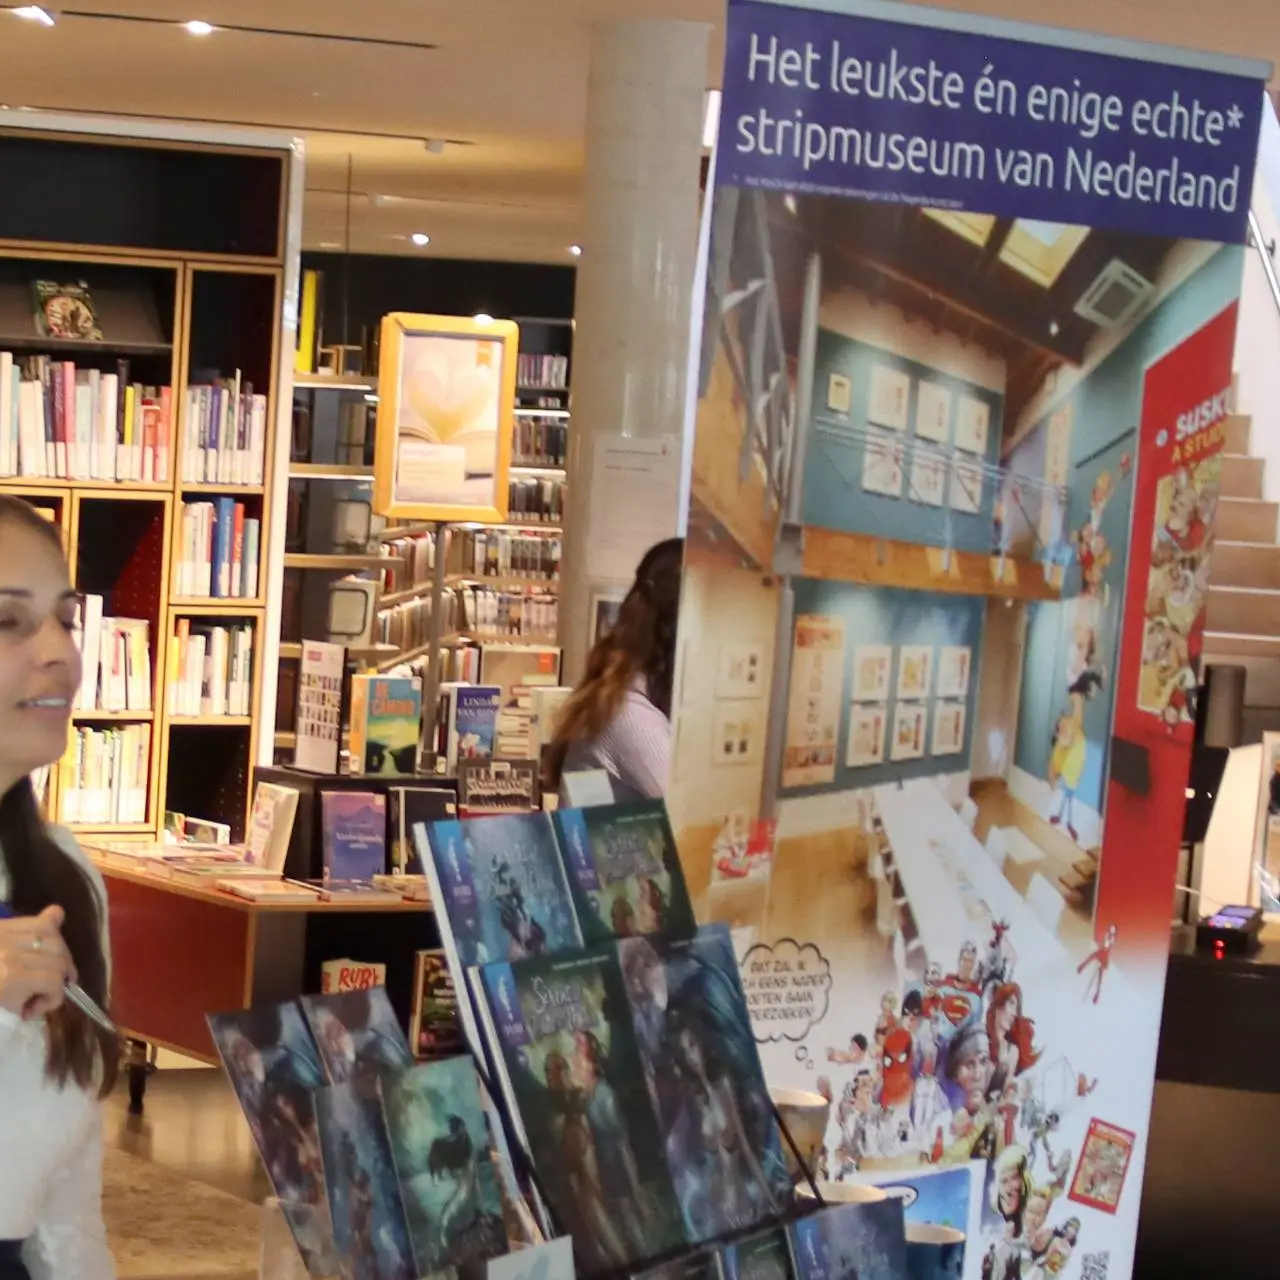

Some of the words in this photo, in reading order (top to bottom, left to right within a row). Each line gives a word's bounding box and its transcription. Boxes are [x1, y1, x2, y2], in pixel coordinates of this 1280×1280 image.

[747, 33, 821, 89] Het
[831, 40, 963, 108] leukste
[978, 64, 1016, 116] én
[1028, 78, 1123, 138] enige
[737, 110, 985, 181] stripmuseum
[994, 145, 1053, 188] van
[1065, 148, 1240, 213] Nederland
